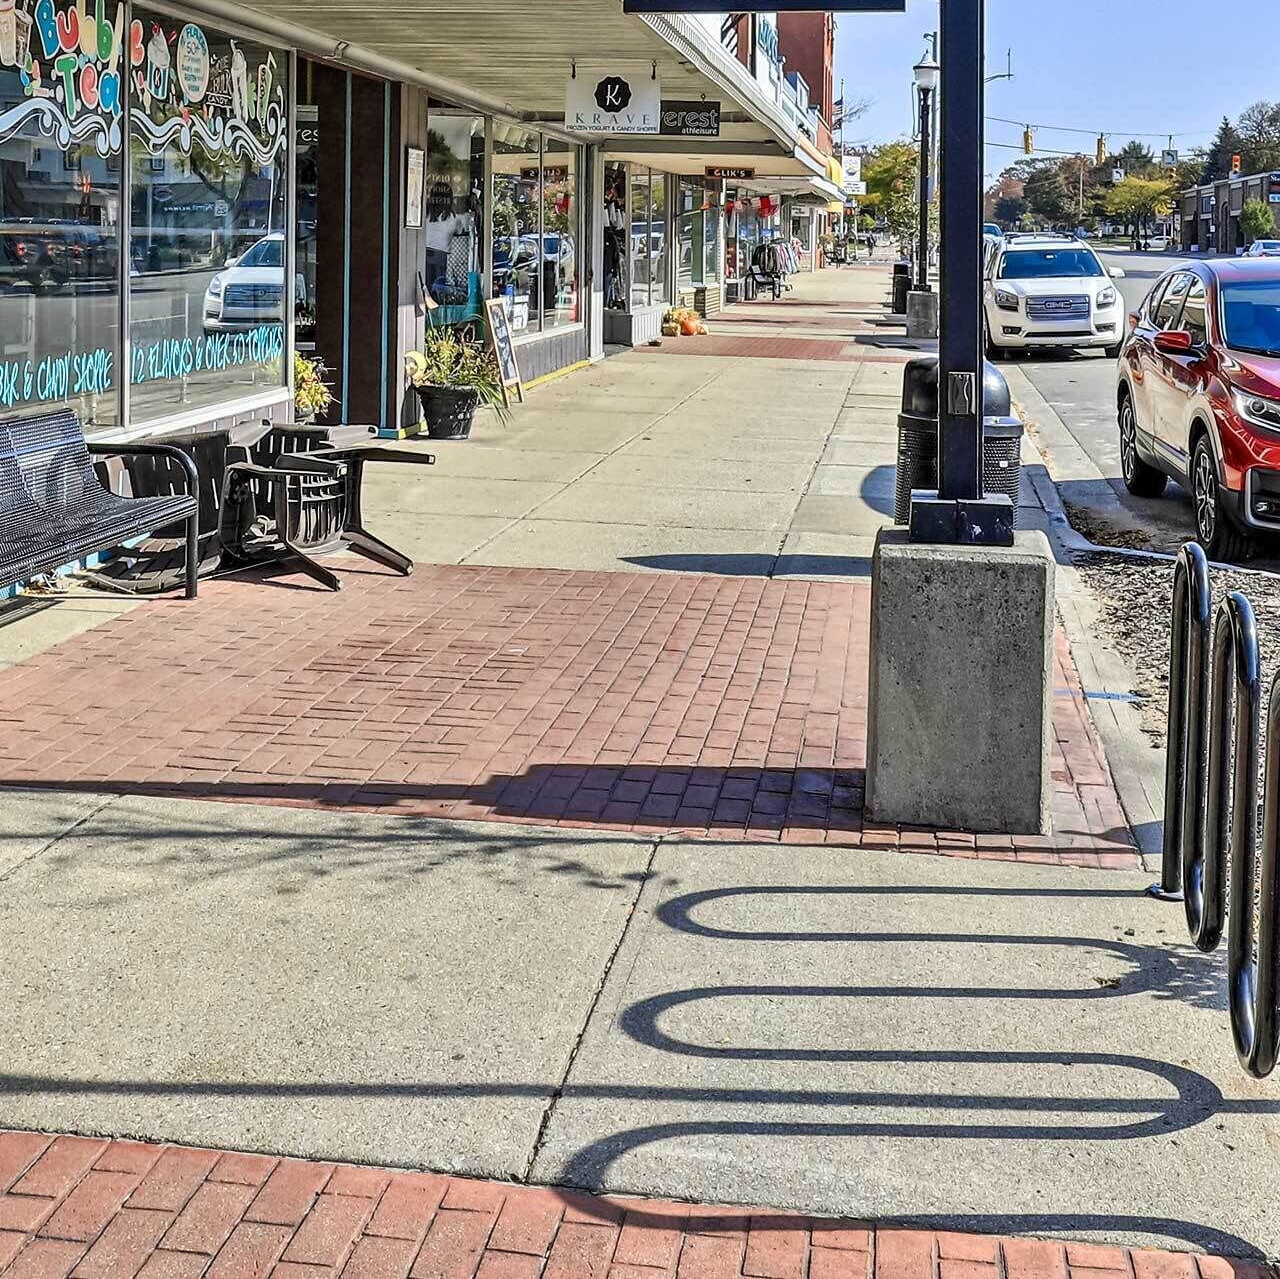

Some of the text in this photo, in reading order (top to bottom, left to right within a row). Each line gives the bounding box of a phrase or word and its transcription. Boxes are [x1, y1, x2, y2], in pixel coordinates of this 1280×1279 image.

[54, 53, 121, 120] Tea
[575, 113, 652, 124] KRAVE
[714, 169, 745, 178] GLIK'S
[1044, 298, 1071, 310] GMC
[149, 338, 193, 379] FLAVORS
[205, 332, 230, 372] OVER
[37, 351, 72, 402] CANDY
[73, 348, 113, 395] SHOPPE
